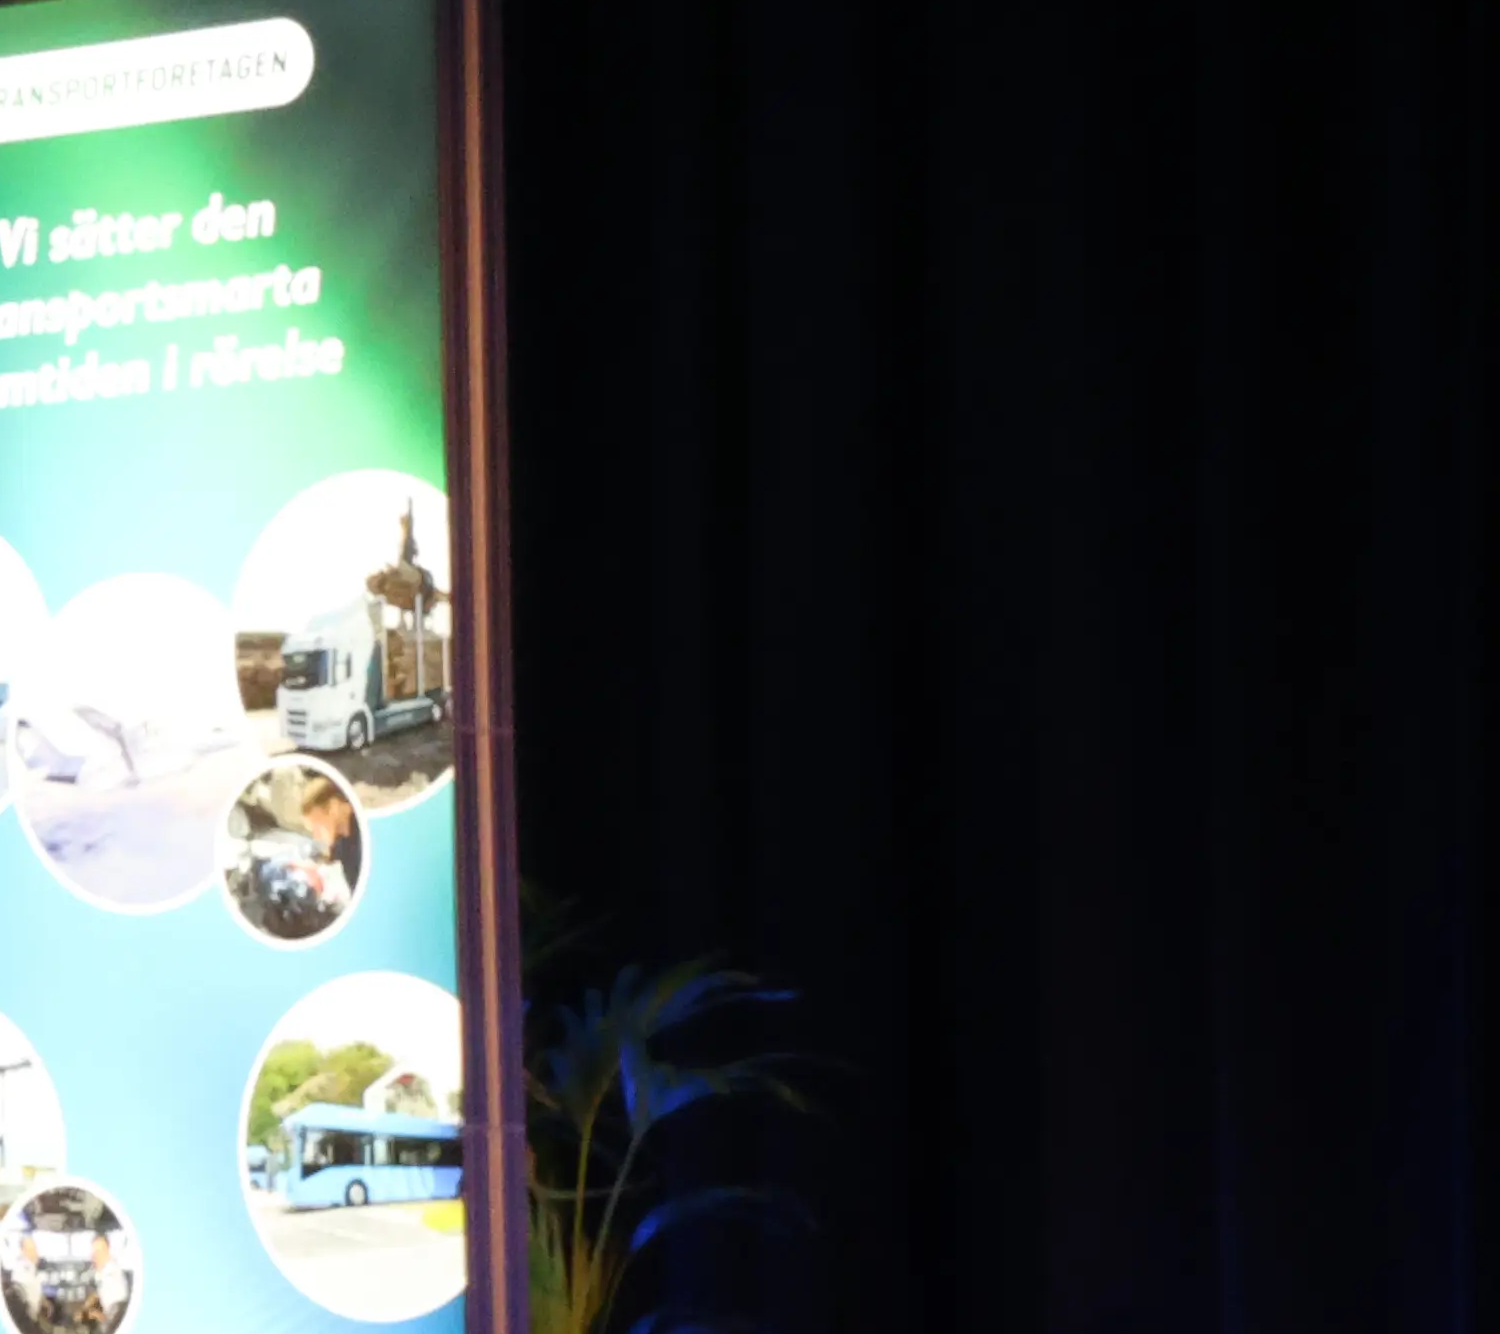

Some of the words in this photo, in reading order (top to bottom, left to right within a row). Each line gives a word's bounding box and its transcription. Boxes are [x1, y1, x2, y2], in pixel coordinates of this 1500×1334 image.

[47, 208, 183, 264] sätter
[191, 192, 276, 244] den
[161, 343, 179, 391] i
[189, 327, 346, 388] rörelse
